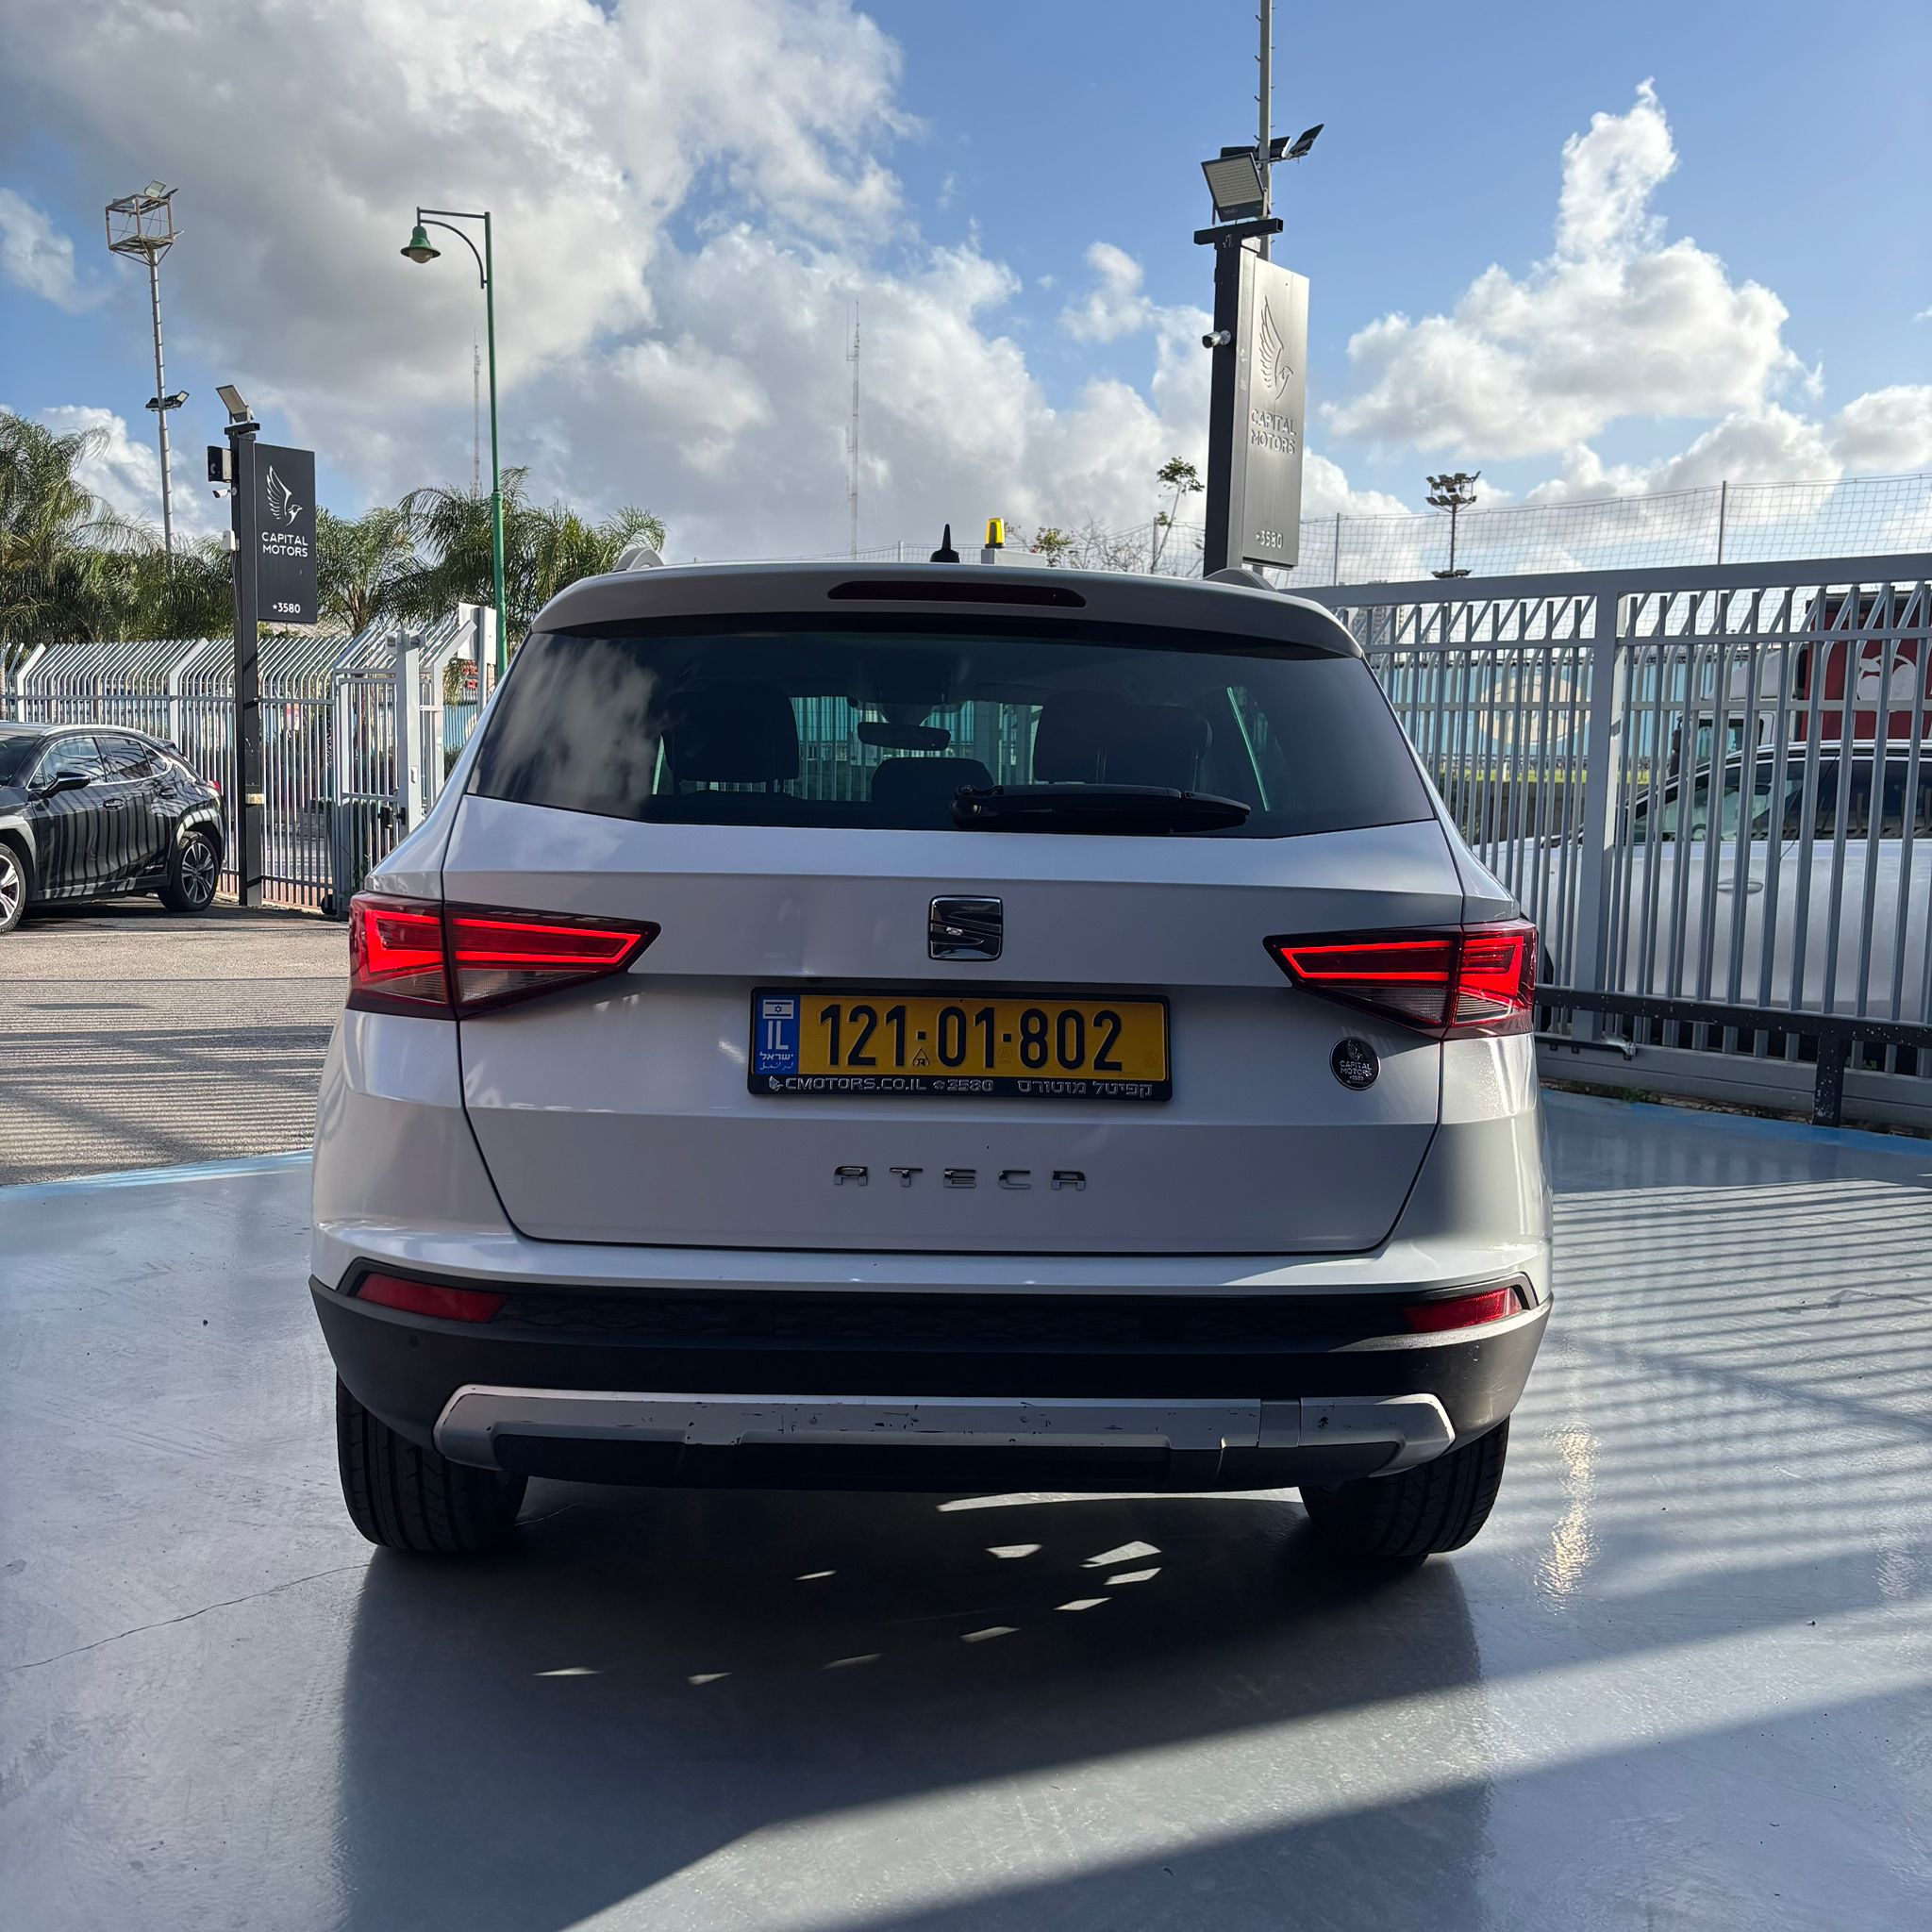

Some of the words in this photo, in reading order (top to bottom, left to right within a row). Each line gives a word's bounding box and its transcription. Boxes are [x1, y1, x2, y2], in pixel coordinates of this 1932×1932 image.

[1250, 408, 1297, 436] CAPITAL
[1251, 429, 1296, 455] MOTORS
[261, 531, 308, 546] CAPITAL
[262, 543, 308, 558] MOTORS
[767, 1020, 789, 1050] IL
[759, 1051, 794, 1060] ישראל
[1340, 1060, 1373, 1071] CAPITAL
[1340, 1067, 1373, 1076] MOTORS
[785, 1077, 926, 1091] CMOTORS.CO.IL
[1017, 1079, 1087, 1094] מוטורס
[1091, 1080, 1153, 1098] קפיטל
[834, 1165, 1087, 1191] ATECA
